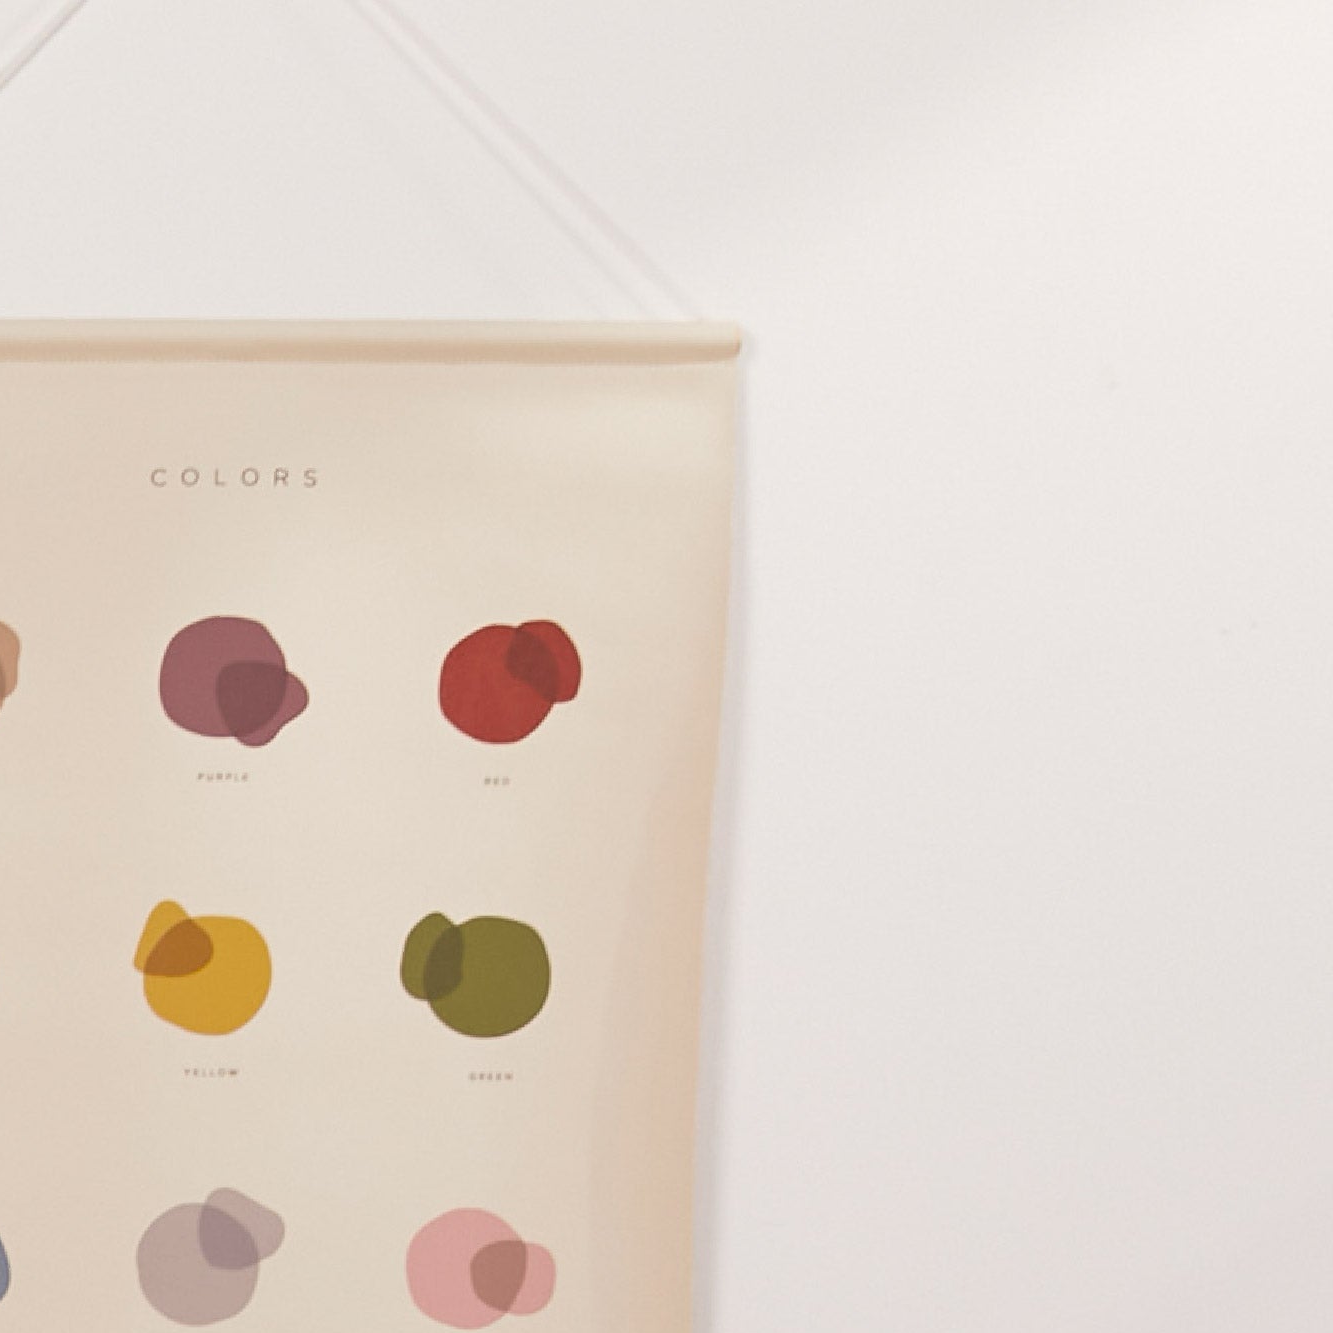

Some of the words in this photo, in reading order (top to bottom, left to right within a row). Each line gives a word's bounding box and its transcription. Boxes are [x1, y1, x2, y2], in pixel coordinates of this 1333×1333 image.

[149, 466, 319, 490] COLORS
[196, 771, 250, 783] PURPLE
[183, 1066, 240, 1078] YELLOW
[467, 1070, 513, 1083] GREEN
